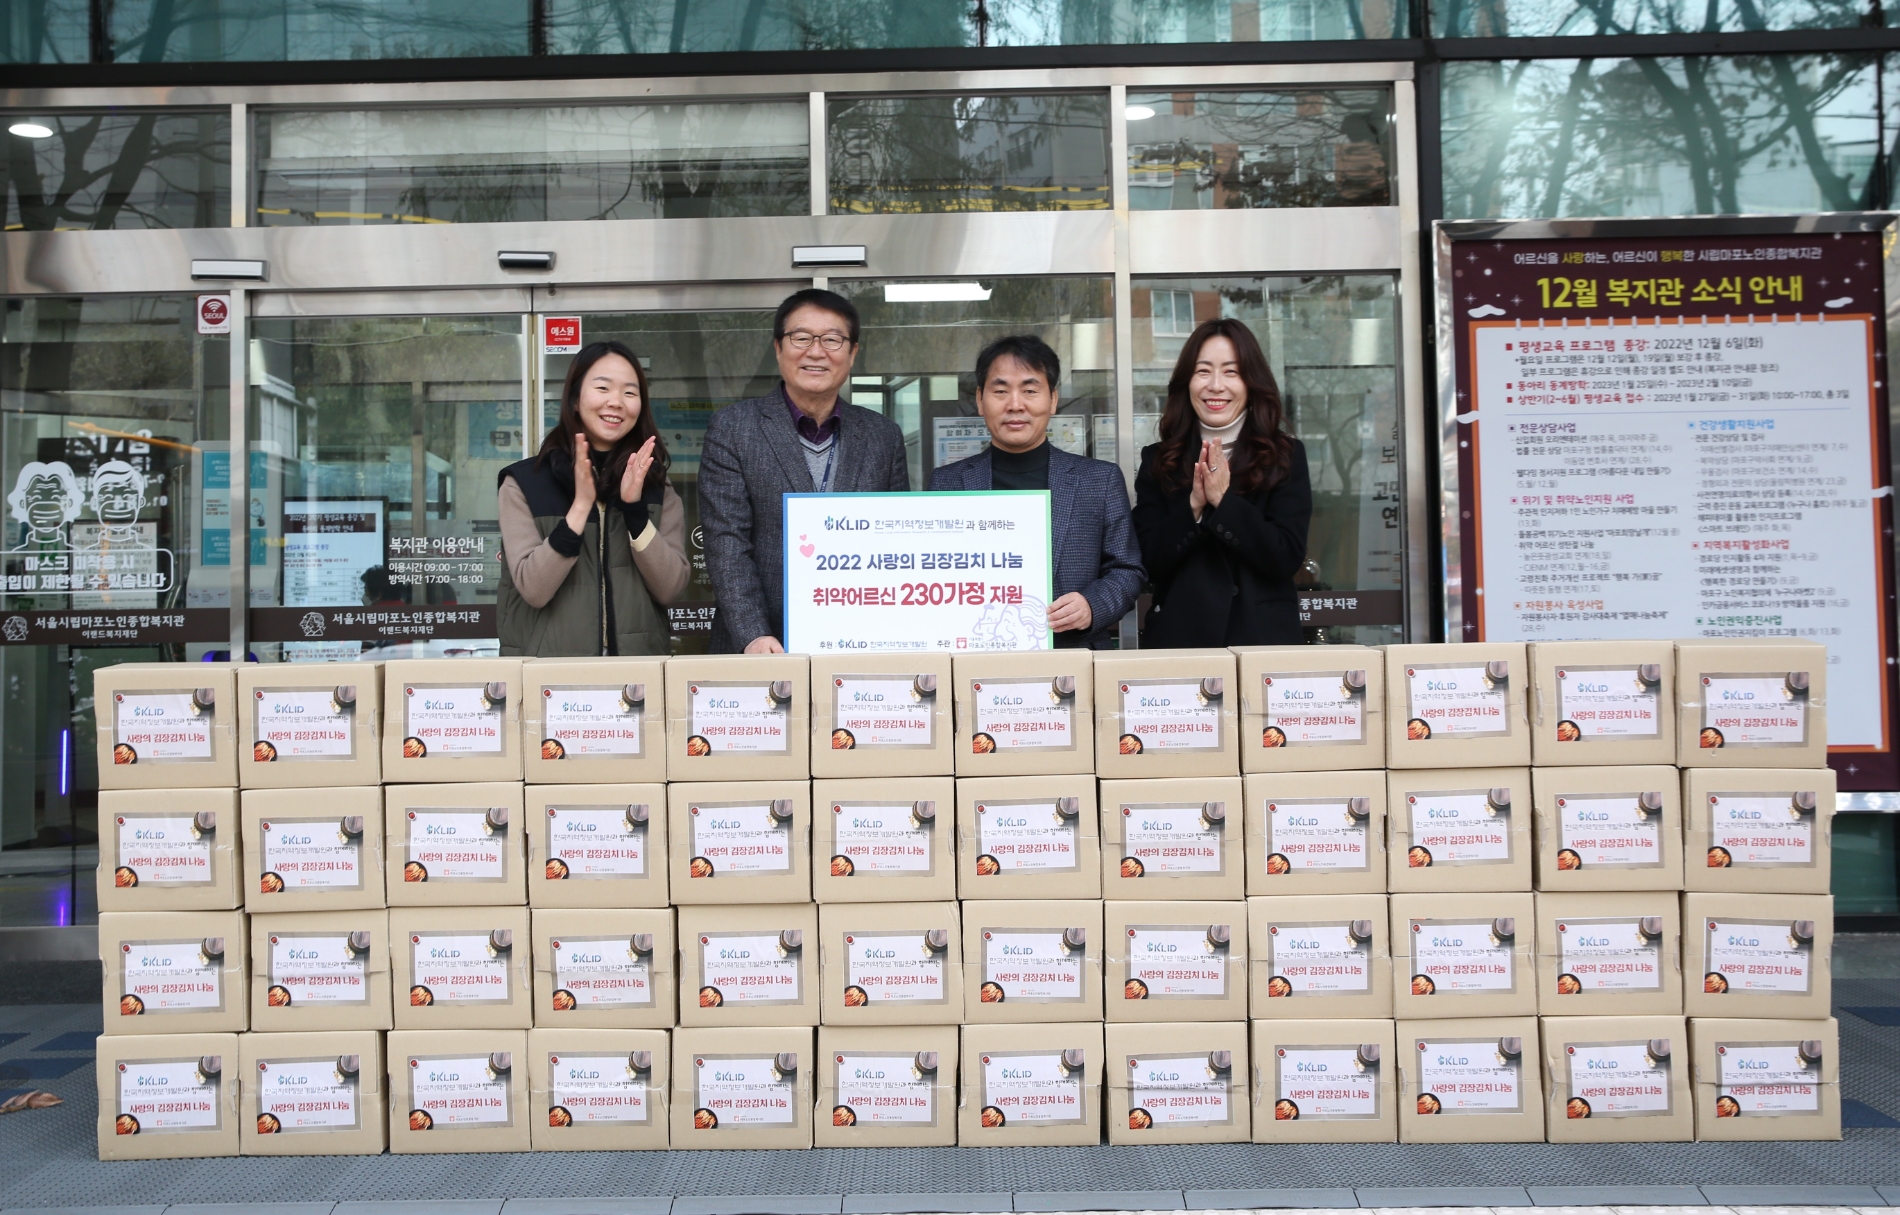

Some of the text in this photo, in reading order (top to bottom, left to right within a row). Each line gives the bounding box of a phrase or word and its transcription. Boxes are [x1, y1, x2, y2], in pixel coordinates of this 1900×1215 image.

[1514, 247, 1822, 265] 어르신을 사랑하는, 어르신이 행복한 시립마포노인종합복지관
[1536, 275, 1803, 309] 12월 복지관 소식 안내
[550, 326, 575, 336] 에스원
[1518, 340, 1566, 354] 평생교육
[1570, 339, 1616, 352] 프로그램
[1654, 338, 1693, 351] 2022년
[1697, 338, 1721, 350] 12월
[1725, 337, 1763, 350] 6일(화)
[1545, 354, 1585, 364] 프로그램은
[1587, 354, 1605, 364] 12월
[1521, 367, 1537, 377] 일부
[1539, 367, 1579, 377] 프로그램은
[1581, 366, 1612, 376] 휴강으로
[1615, 366, 1631, 376] 인해
[1651, 366, 1666, 375] 일정
[1669, 365, 1685, 375] 별도
[1687, 365, 1703, 374] 안내
[1518, 381, 1545, 392] 동아리
[1592, 380, 1620, 390] 2023년
[1622, 380, 1635, 390] 1월
[1676, 379, 1705, 388] 2023년
[1706, 378, 1719, 388] 2월
[1584, 393, 1621, 404] 평생교육
[1625, 393, 1644, 403] 접수
[1654, 393, 1682, 402] 2023년
[1836, 390, 1849, 399] 3일
[1519, 423, 1576, 434] 전문상담사업
[1699, 419, 1775, 430] 건강생활지원사업
[1523, 494, 1635, 505] 위기 및 취약노인지원 사업
[836, 516, 870, 531] KLID
[978, 519, 1016, 531] 함께하는
[389, 537, 429, 554] 복지관
[433, 536, 484, 554] 이용안내
[1704, 539, 1790, 550] 지역복지활성화사업
[25, 555, 135, 571] 마스크 미착용 시
[816, 552, 1024, 571] 2022 사랑의 김장김치 나눔
[389, 563, 484, 573] 이용시간 09:00 17:00
[41, 574, 85, 590] 제한될
[89, 574, 103, 589] 수
[109, 573, 166, 588] 있습니다
[388, 574, 484, 585] 방역시간 17:00 18:00
[813, 582, 1023, 606] 취약어르신 230가정 지원
[1300, 598, 1358, 610] 종합복지관
[1525, 599, 1604, 611] 자원봉사 육성사업
[35, 615, 185, 629] 서울시립마포노인종합복지관
[332, 611, 481, 625] 서울시립마포노인종합복지관
[1708, 615, 1782, 626] 노인권익증진사업
[82, 629, 138, 639] 이랜드복지재단
[378, 626, 434, 635] 이랜드복지재단
[845, 639, 867, 648] KLID
[1585, 683, 1608, 693] KLID
[716, 699, 739, 709] KLID
[1147, 697, 1170, 706] KLID
[282, 704, 304, 713] KLID
[1570, 710, 1651, 720] 사랑의 김장김치 나눔
[701, 726, 781, 736] 사랑의 김장김치 나눔
[1133, 723, 1213, 733] 사랑의 김장김치 나눔
[267, 731, 346, 740] 사랑의 김장김치 나눔
[1435, 808, 1459, 818] KLID
[717, 819, 741, 829] KLID
[1422, 834, 1502, 845] 사랑의 김장김치 나눔
[703, 845, 783, 856] 사랑의 김장김치 나눔
[1439, 937, 1462, 947] KLID
[727, 949, 750, 958] KLID
[1425, 964, 1505, 974] 사랑의 김장김치 나눔
[713, 975, 792, 986] 사랑의 김장김치 나눔
[1445, 1056, 1469, 1065] KLID
[285, 1075, 308, 1085] KLID
[722, 1072, 745, 1081] KLID
[1431, 1083, 1512, 1093] 사랑의 김장김치 나눔
[271, 1101, 349, 1112] 사랑의 김장김치 나눔
[708, 1099, 787, 1108] 사랑의 김장김치 나눔
